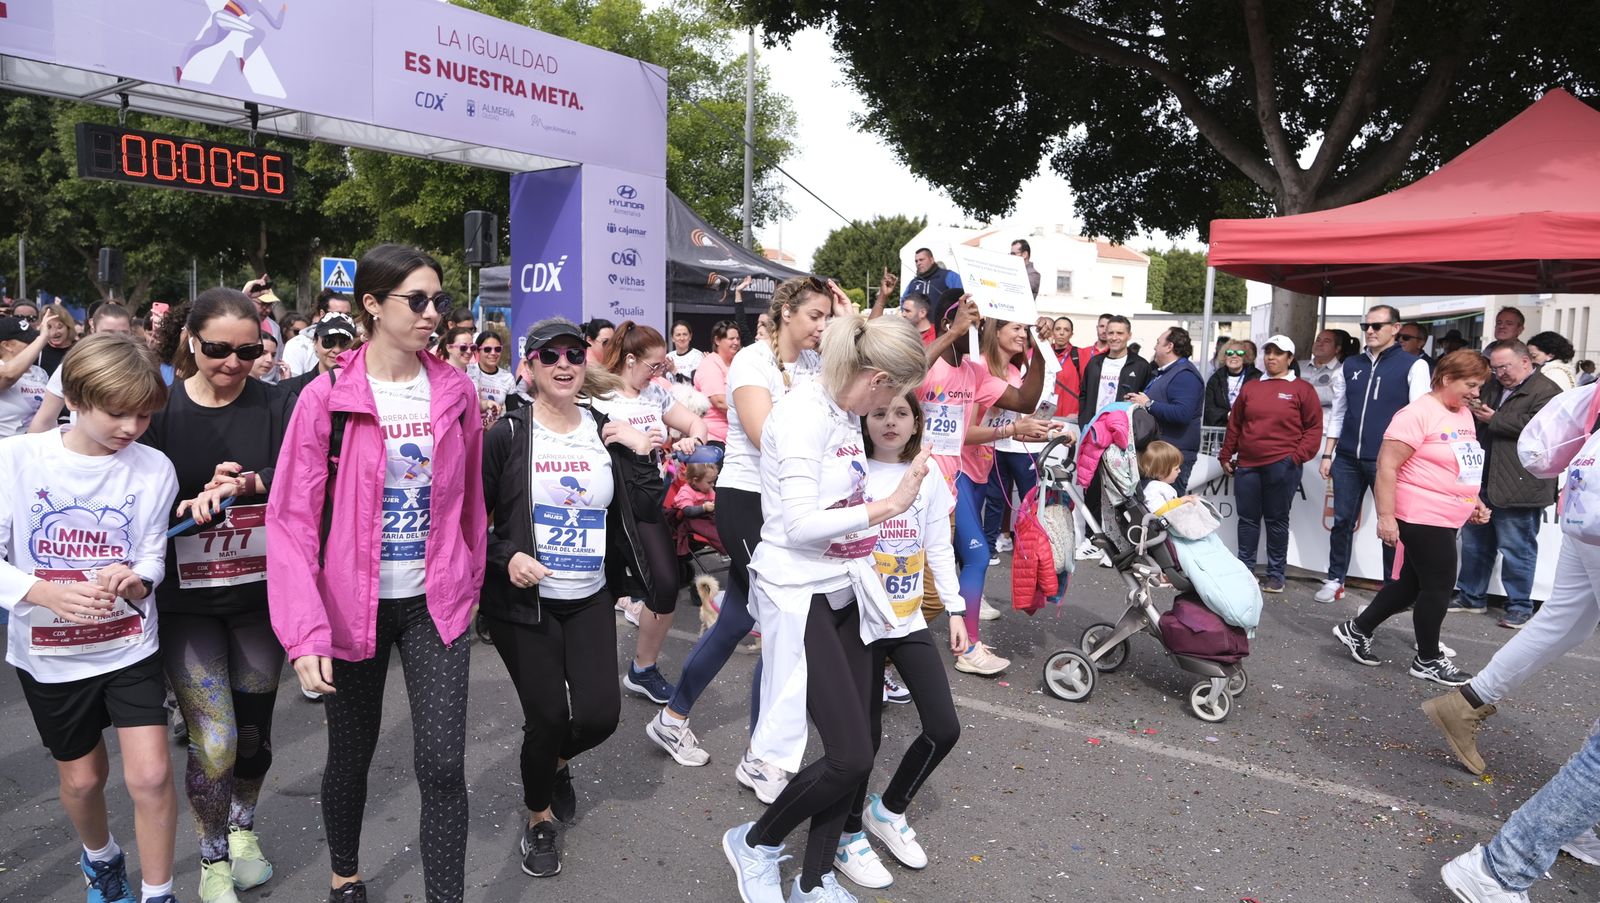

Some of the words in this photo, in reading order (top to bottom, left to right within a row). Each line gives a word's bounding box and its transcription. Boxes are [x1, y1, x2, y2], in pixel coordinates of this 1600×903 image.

[437, 25, 461, 49] LA
[467, 34, 559, 75] IGUALDAD
[404, 51, 432, 75] ES
[436, 58, 527, 98] NUESTRA
[531, 83, 585, 111] META.
[415, 91, 448, 112] CDX
[121, 134, 285, 194] 00:00:56
[609, 199, 645, 210] HYUNDAI
[618, 225, 647, 236] cajamar
[521, 255, 568, 293] CDX
[619, 275, 646, 287] vithas
[614, 306, 645, 317] aqualia
[628, 414, 657, 426] MUJER
[926, 417, 957, 433] 1299
[535, 460, 592, 473] MUJER
[1462, 454, 1483, 466] 1310
[382, 509, 431, 533] 222
[543, 512, 564, 520] MUJER
[883, 519, 908, 529] MINI
[58, 528, 108, 545] MINI
[199, 528, 252, 553] 777
[547, 526, 588, 548] 221
[877, 528, 917, 539] UNNER
[38, 539, 124, 558] RUNNER
